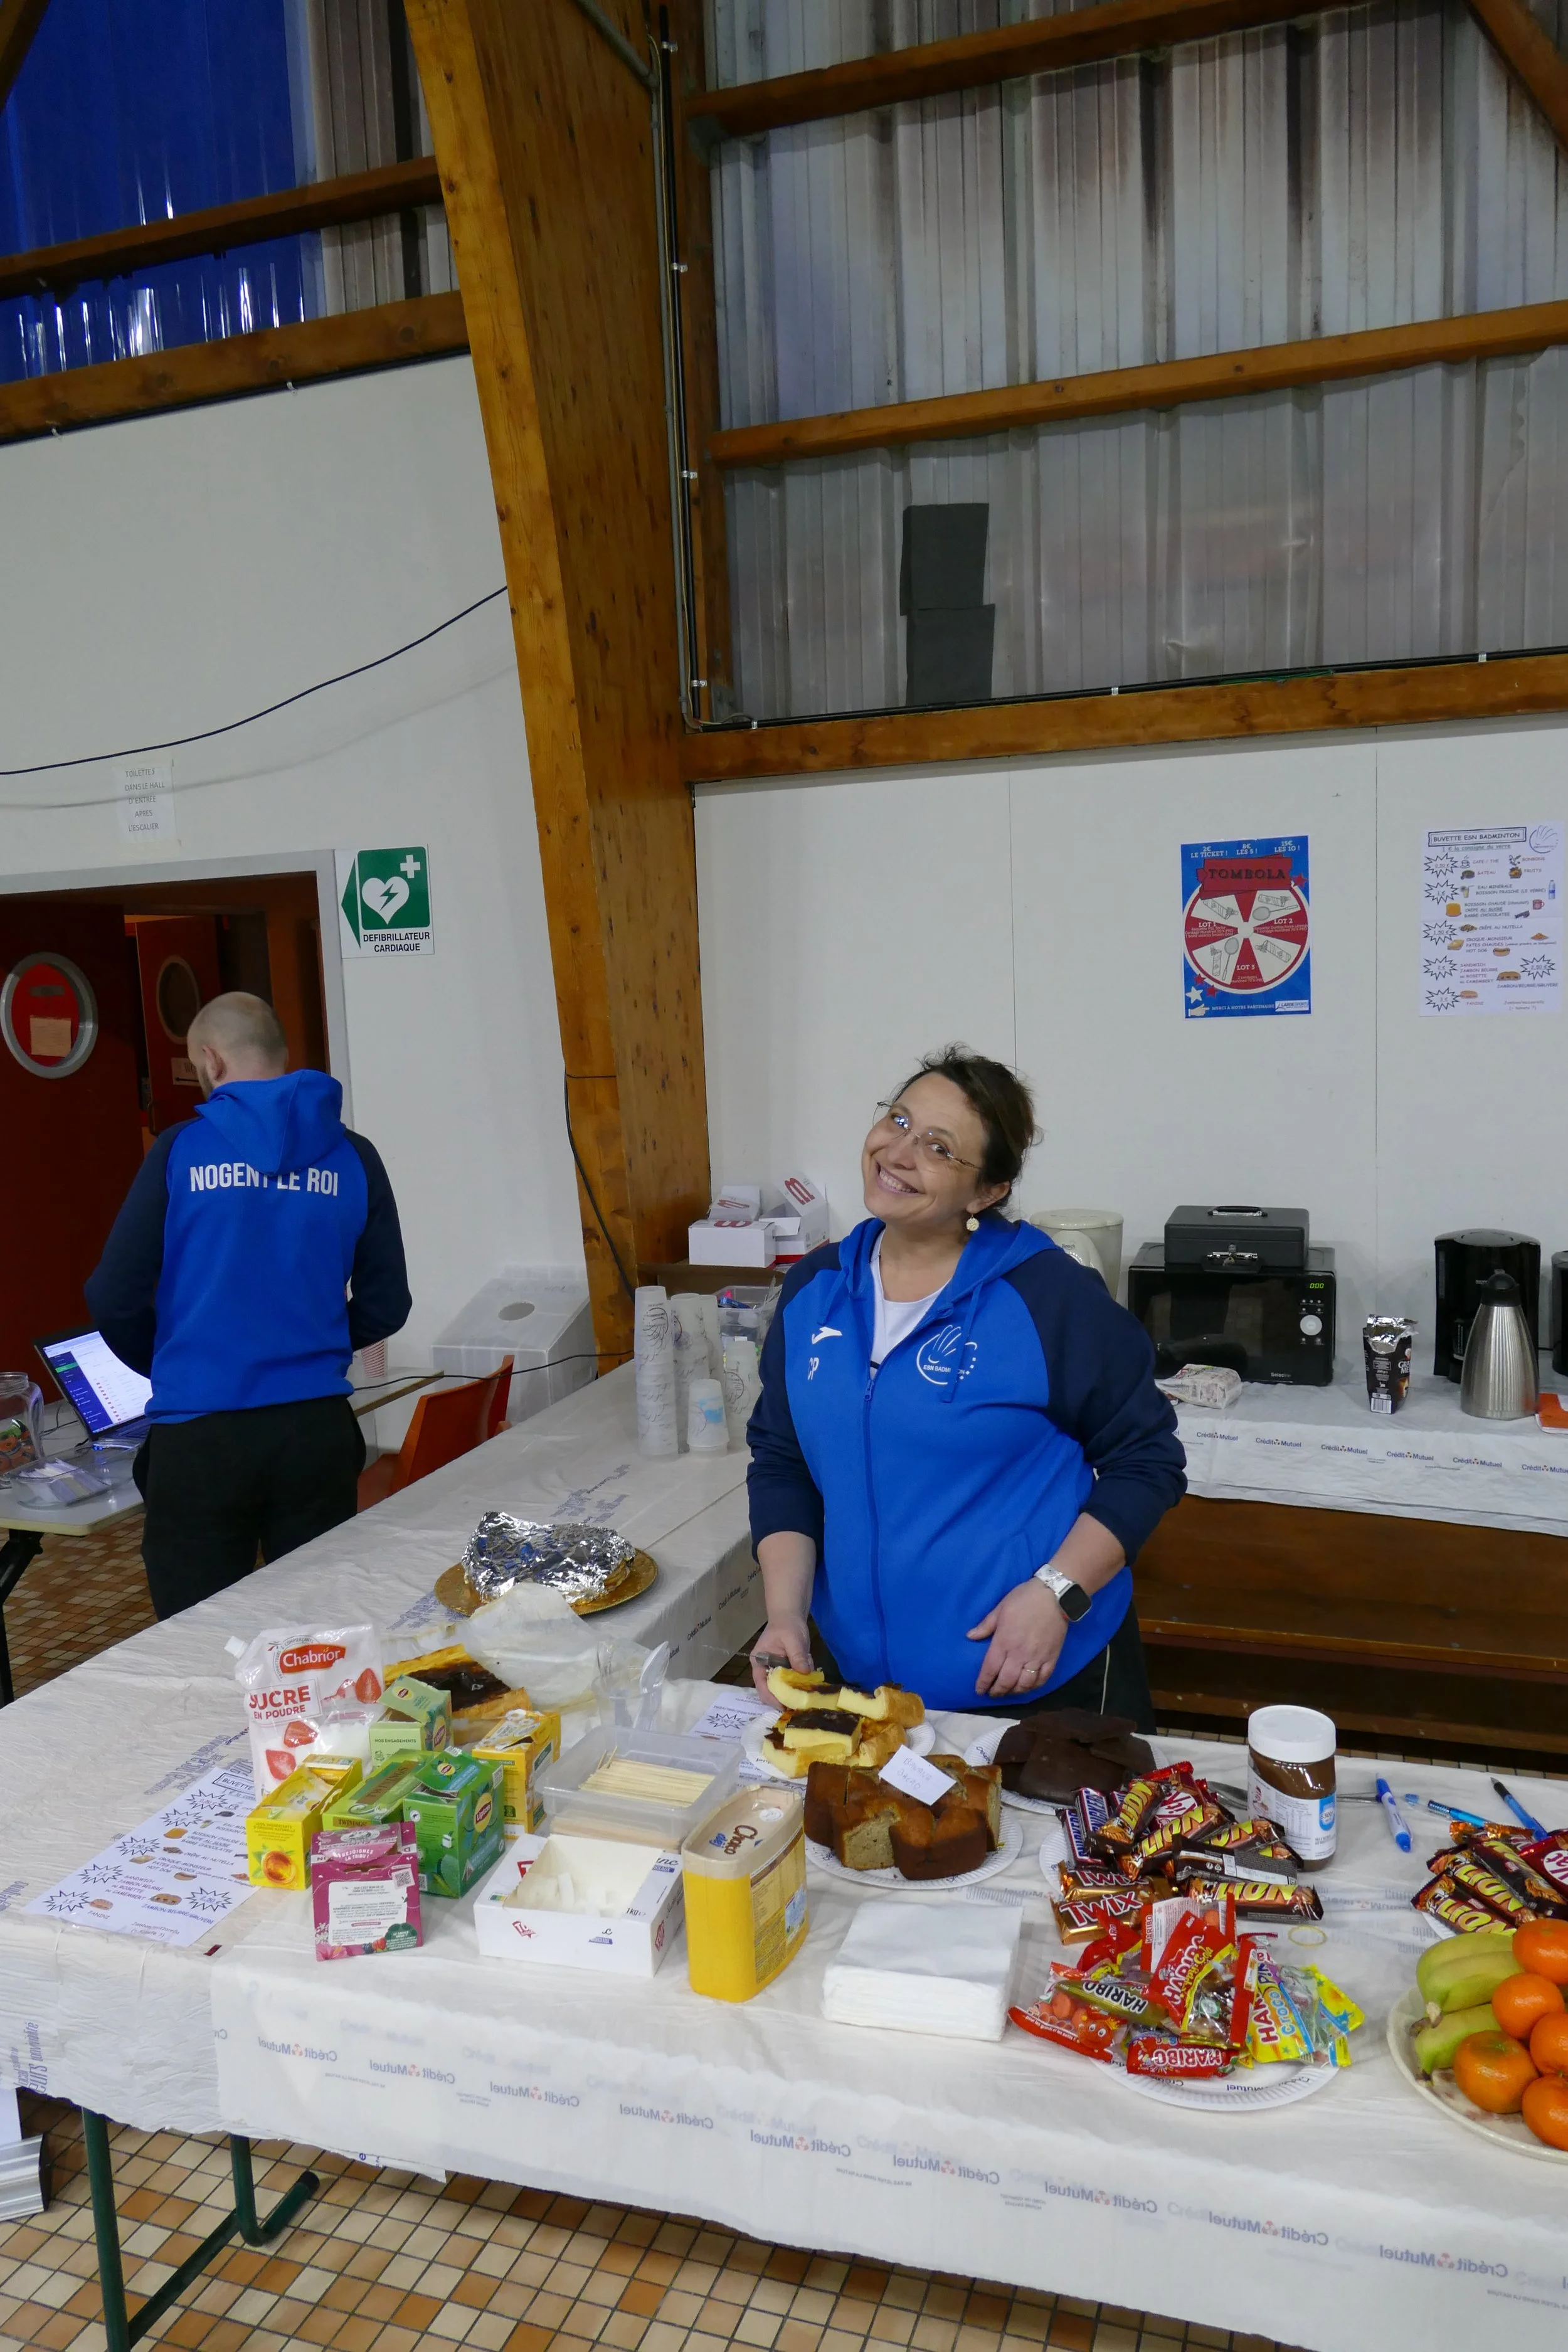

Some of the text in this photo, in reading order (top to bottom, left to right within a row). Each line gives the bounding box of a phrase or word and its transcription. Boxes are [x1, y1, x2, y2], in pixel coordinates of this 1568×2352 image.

[125, 768, 155, 777] TOILETTES
[129, 823, 159, 832] L'ESCALIER
[1208, 868, 1286, 879] TOMBOLA
[363, 932, 430, 941] DEFIBRILLATEUR
[374, 943, 420, 952] CARDIAQUE
[307, 1167, 338, 1197] ROI
[1256, 1437, 1274, 1445] Crédit
[1321, 1444, 1368, 1455] Crédit Mutuel
[1412, 1453, 1434, 1461] Mutuel
[1453, 1457, 1503, 1468] Crédit Mutuel
[282, 1647, 341, 1667] Chabrior
[249, 1685, 311, 1710] SUCRE
[254, 1705, 306, 1720] EN POUDRE
[476, 1802, 492, 1823] Lipton
[1119, 1781, 1153, 1832] LION
[724, 1825, 758, 1855] Choco
[1141, 1806, 1204, 1857] LION
[112, 1890, 146, 1901] CAMEMBERT
[1214, 1882, 1298, 1903] LION
[1454, 1865, 1523, 1912] LION
[87, 1911, 110, 1920] PANINI
[1060, 1890, 1144, 1928] Twix
[1162, 1935, 1205, 2005] HARIBO
[1083, 1981, 1148, 2015] HARIBO
[1153, 2048, 1222, 2068] HARIBO
